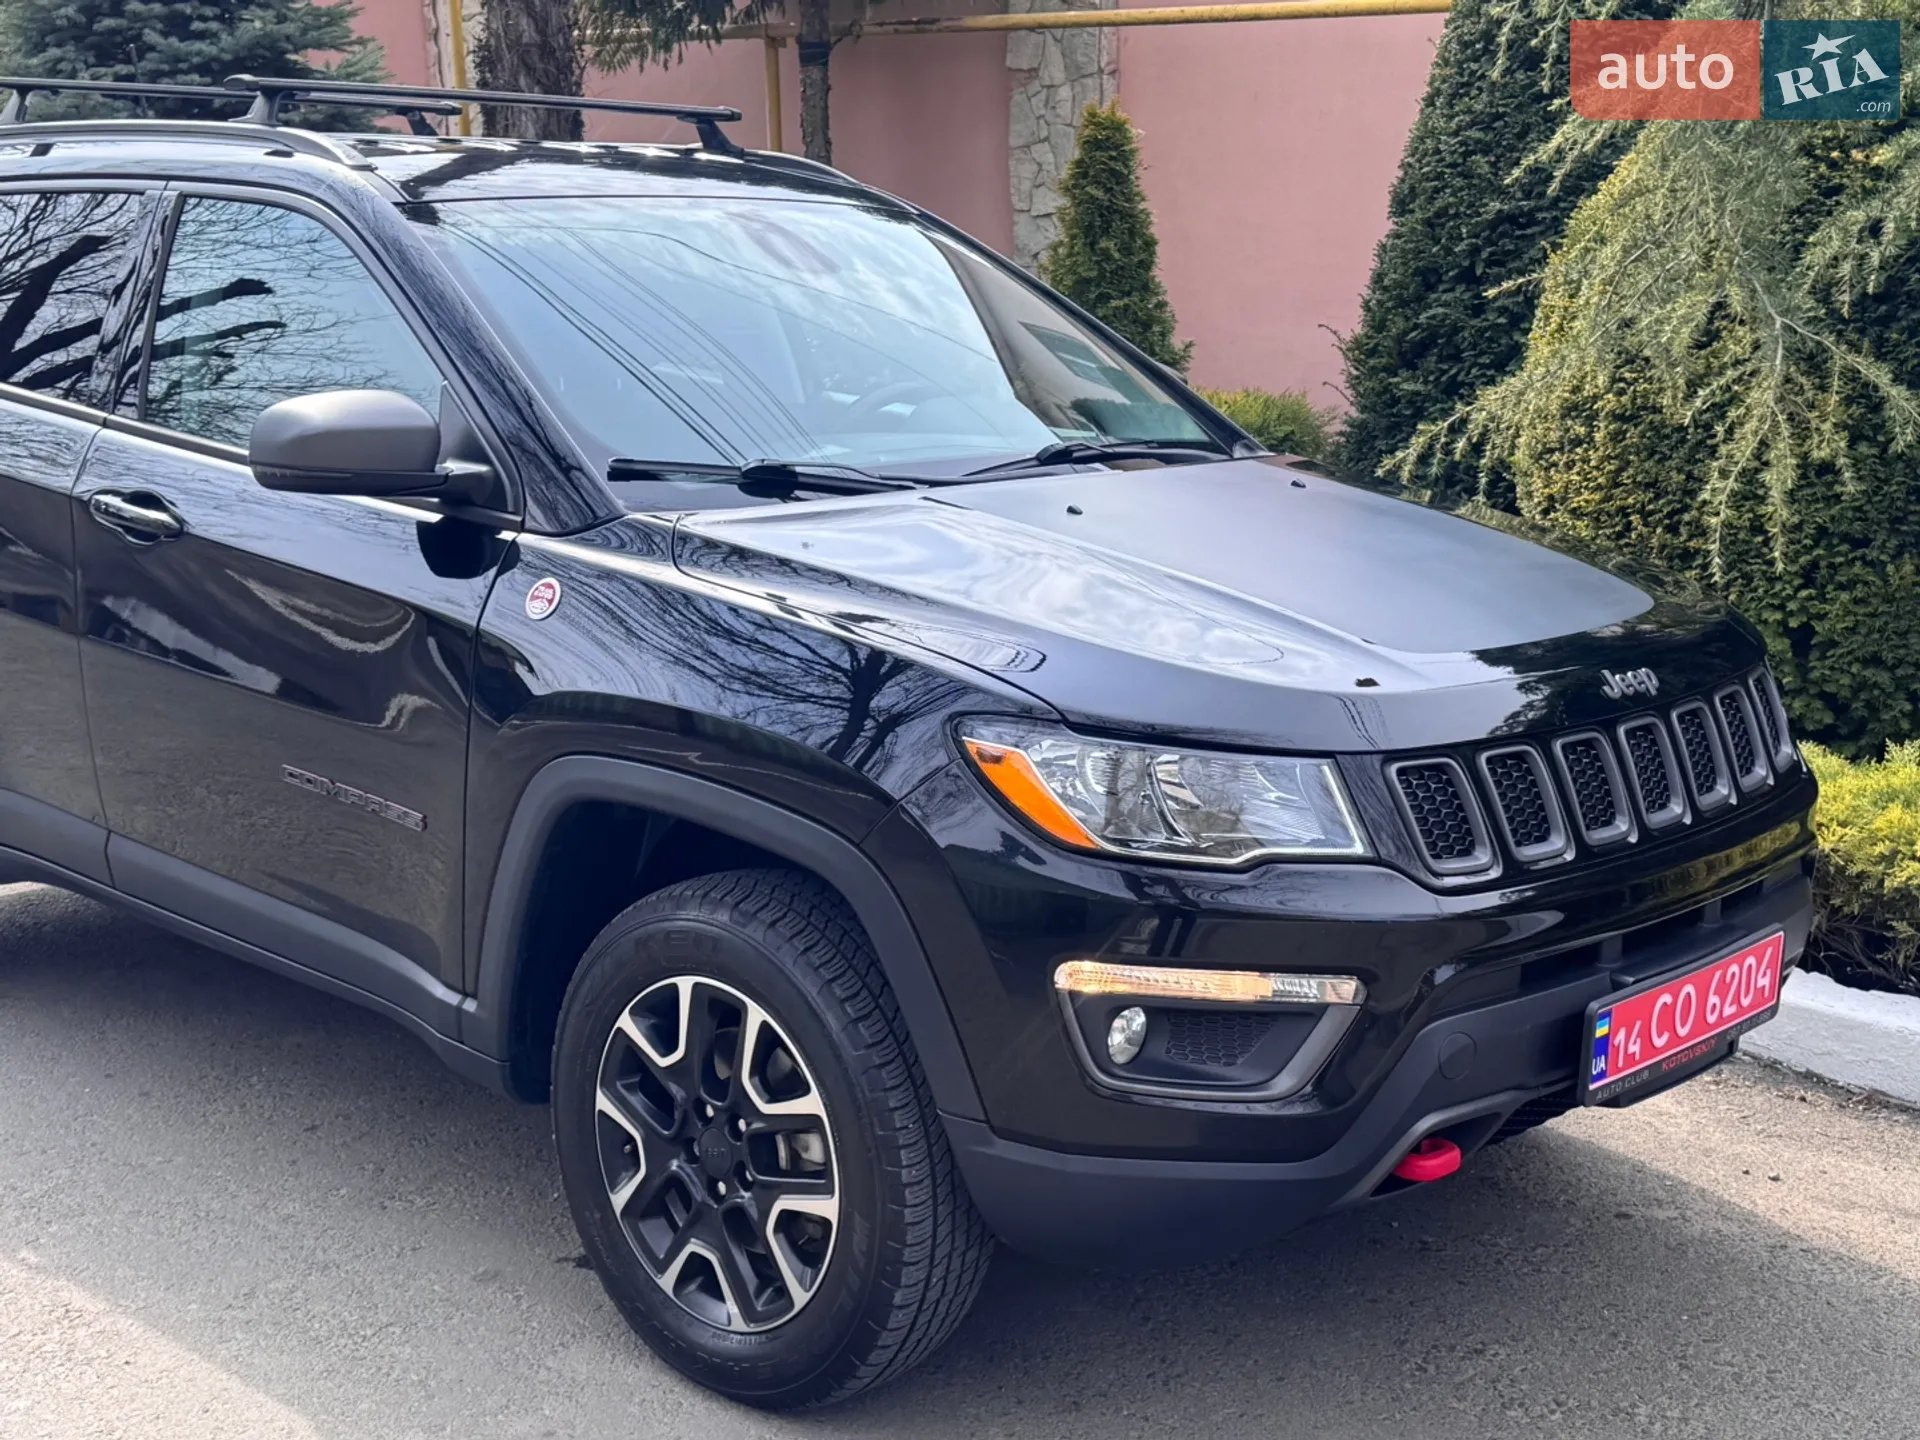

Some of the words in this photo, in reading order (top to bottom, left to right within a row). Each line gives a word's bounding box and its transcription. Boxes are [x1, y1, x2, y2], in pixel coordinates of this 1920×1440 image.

[1600, 667, 1659, 699] Jeep
[1613, 1020, 1642, 1069] 14
[1650, 983, 1697, 1048] CO
[1705, 946, 1773, 1025] 6204
[1592, 1054, 1606, 1075] UA
[1596, 1082, 1622, 1101] AUTO
[1625, 1069, 1649, 1088] CLUB
